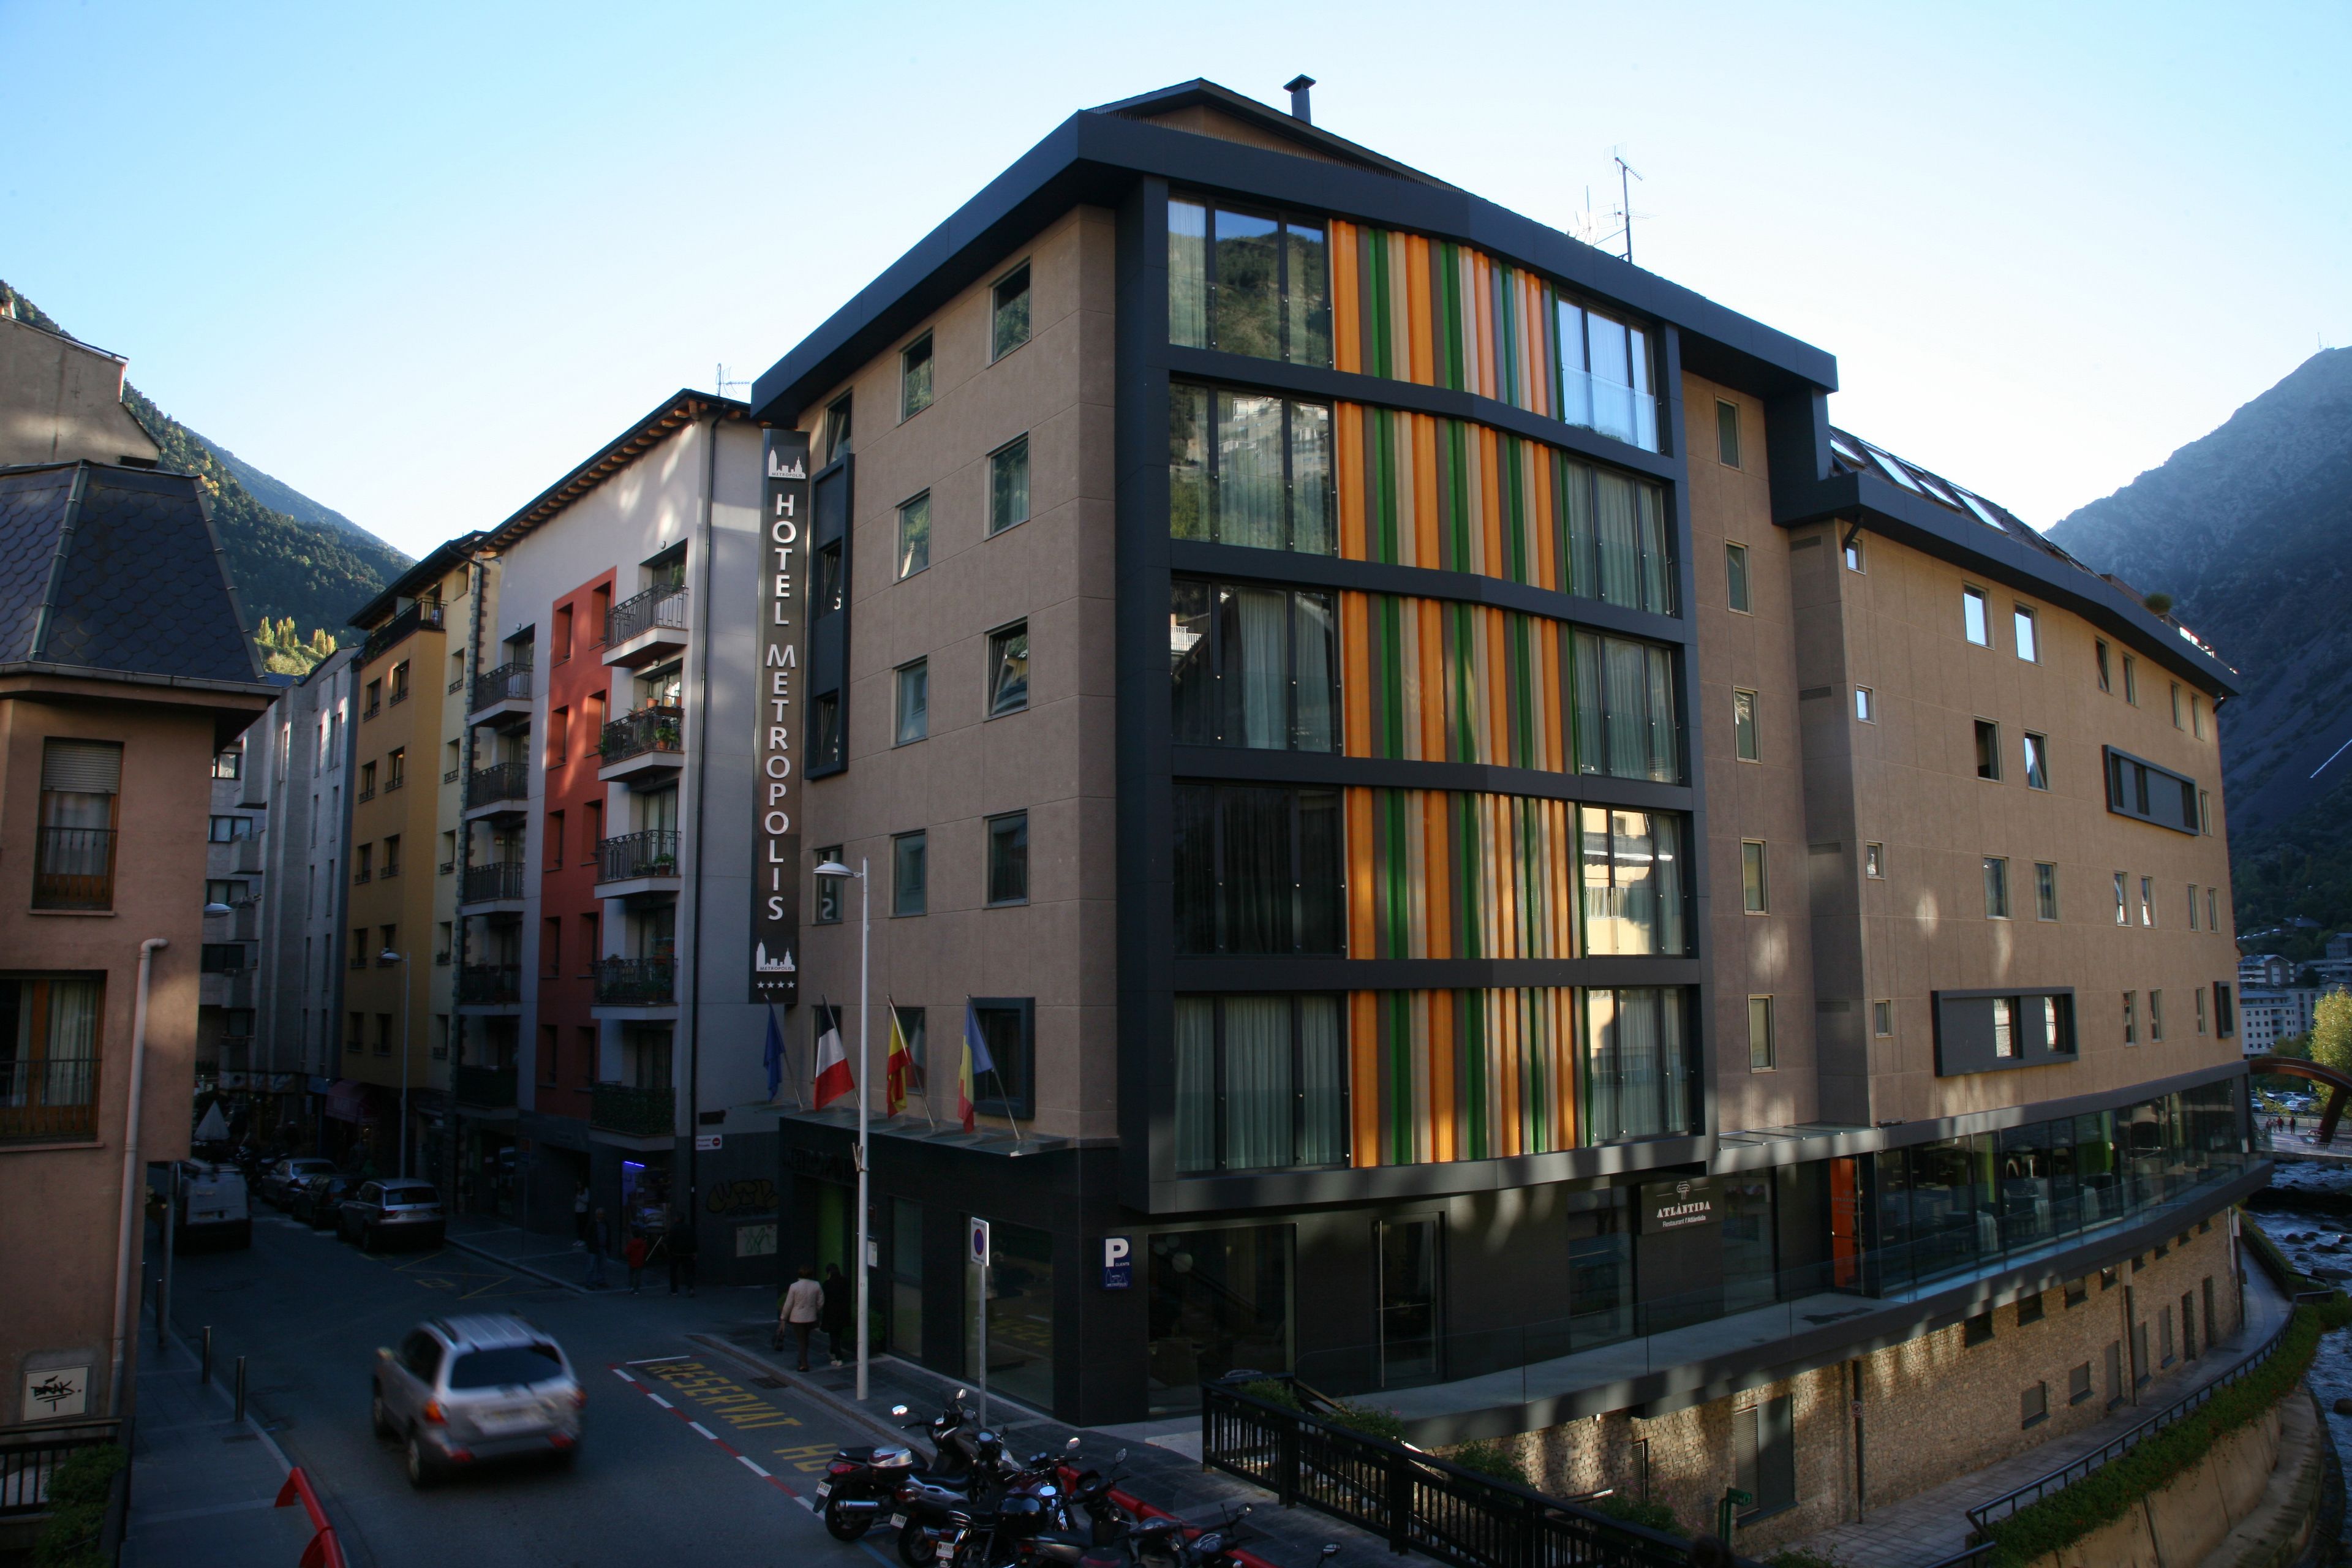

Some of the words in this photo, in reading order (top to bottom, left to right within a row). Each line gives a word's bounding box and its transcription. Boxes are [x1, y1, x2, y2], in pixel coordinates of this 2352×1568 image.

[772, 494, 796, 625] HOTEL
[765, 644, 796, 921] METROPOLIS
[1656, 1200, 1711, 1218] ATLÀNTIDA
[1662, 1218, 1684, 1227] Restaurant
[1105, 1238, 1129, 1267] P
[646, 1362, 804, 1430] RESERVAT
